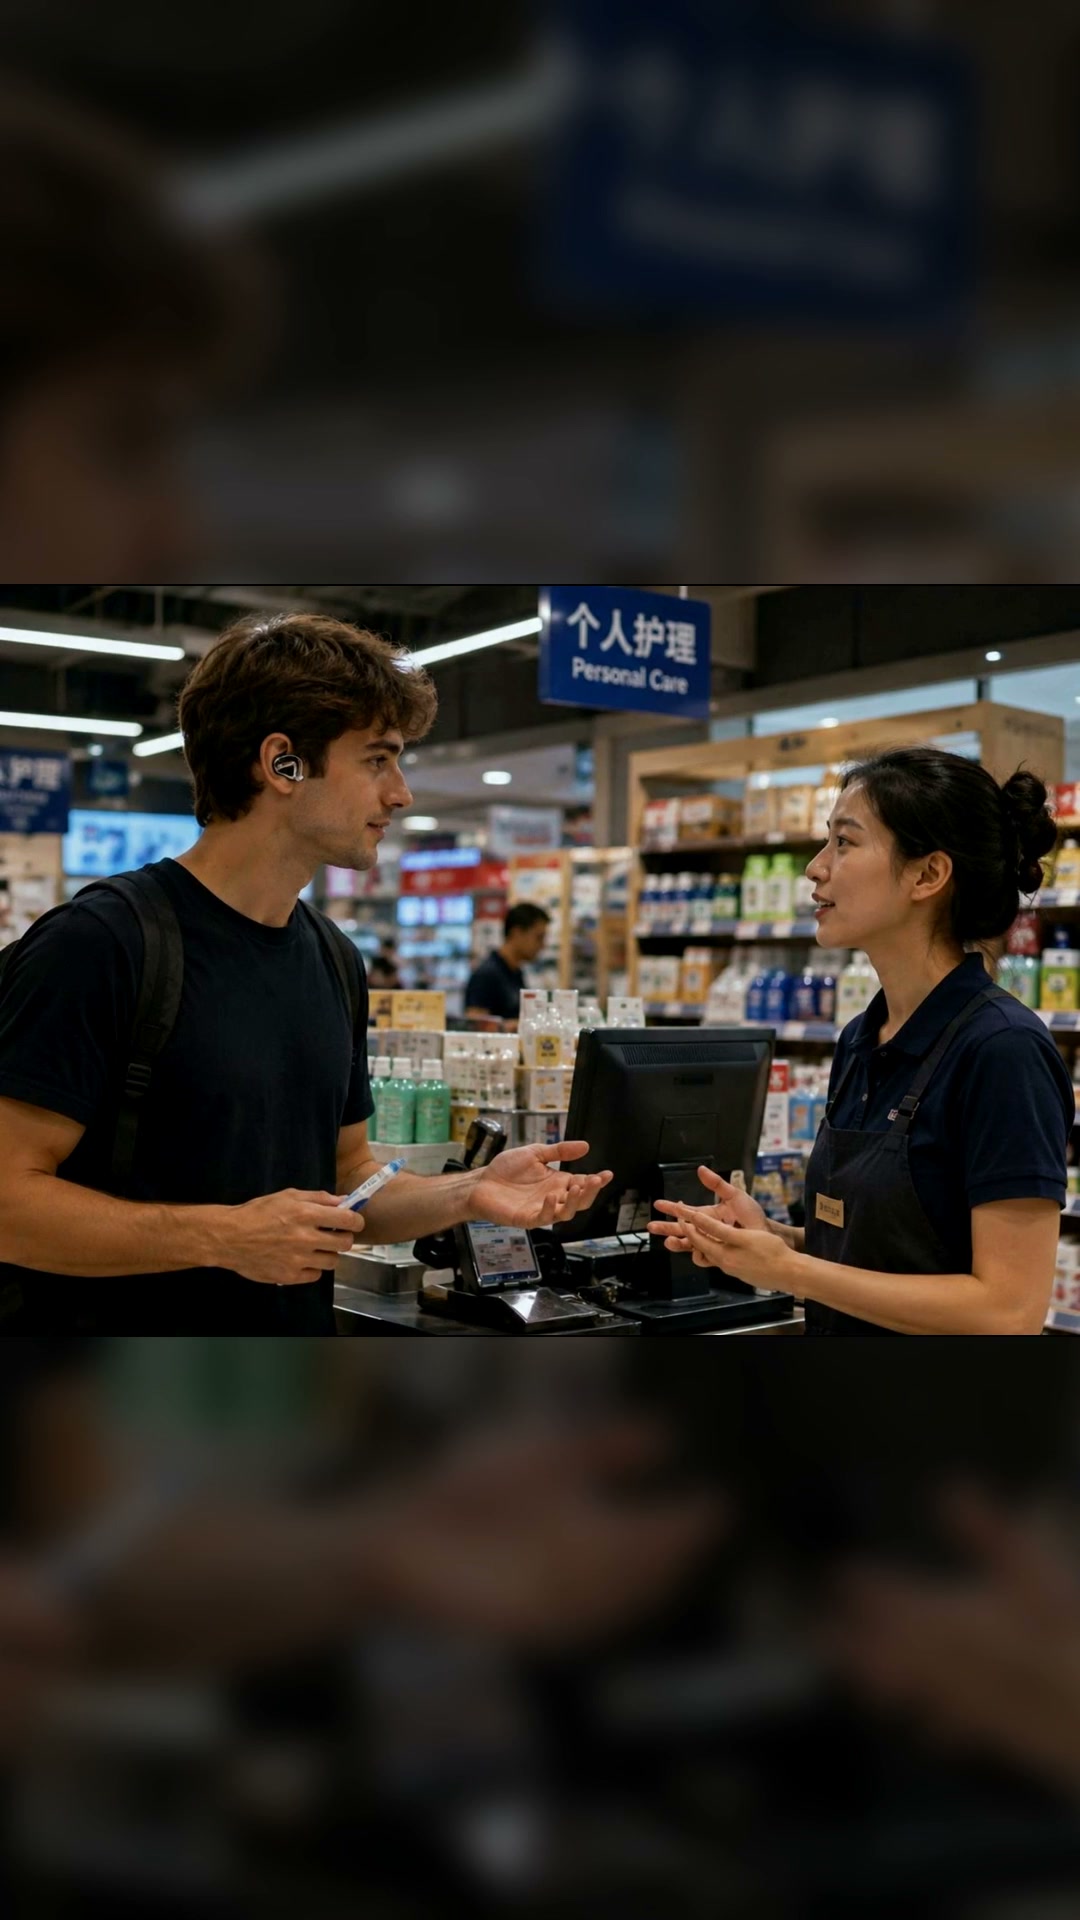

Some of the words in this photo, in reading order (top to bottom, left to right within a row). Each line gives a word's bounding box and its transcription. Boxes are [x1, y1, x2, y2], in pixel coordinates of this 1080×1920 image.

[567, 602, 697, 665] 个人护理
[572, 657, 647, 688] Personal
[650, 670, 689, 694] Care
